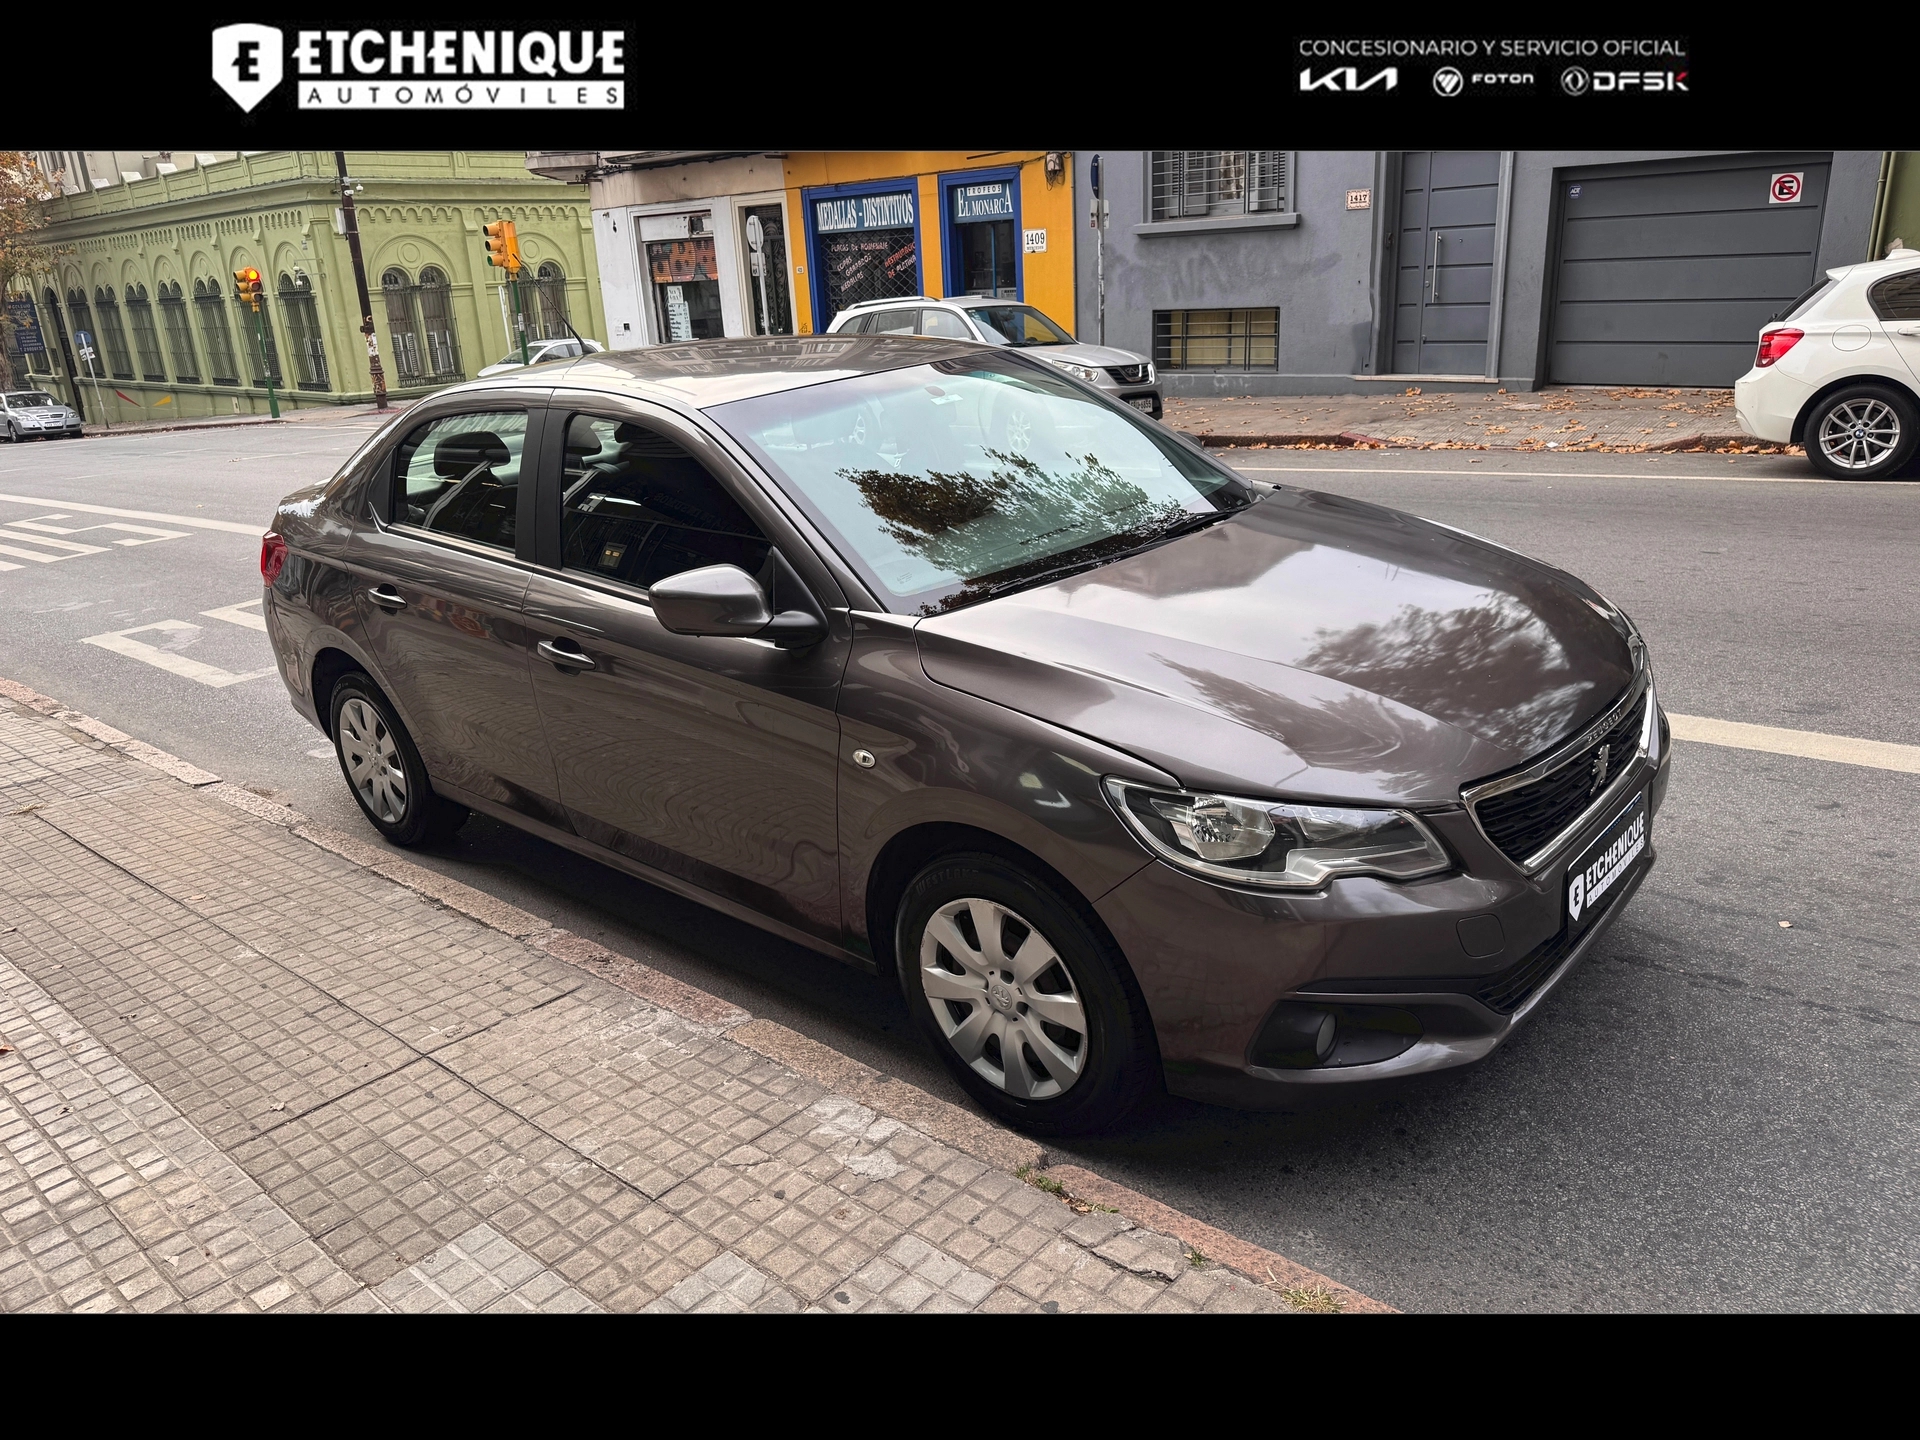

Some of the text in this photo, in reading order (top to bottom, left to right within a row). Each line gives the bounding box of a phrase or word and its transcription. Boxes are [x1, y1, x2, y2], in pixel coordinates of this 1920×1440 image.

[967, 185, 1001, 195] TROFEOS
[972, 183, 1013, 216] MONARCA
[1350, 194, 1368, 202] 1417
[816, 199, 857, 231] MEDALLAS
[863, 193, 914, 228] DISTINTIVOS
[1026, 232, 1045, 245] 1409
[1587, 708, 1622, 743] PEUGEOT
[1586, 811, 1644, 891] ETCHENIQUE
[915, 867, 979, 897] WESTLAKE
